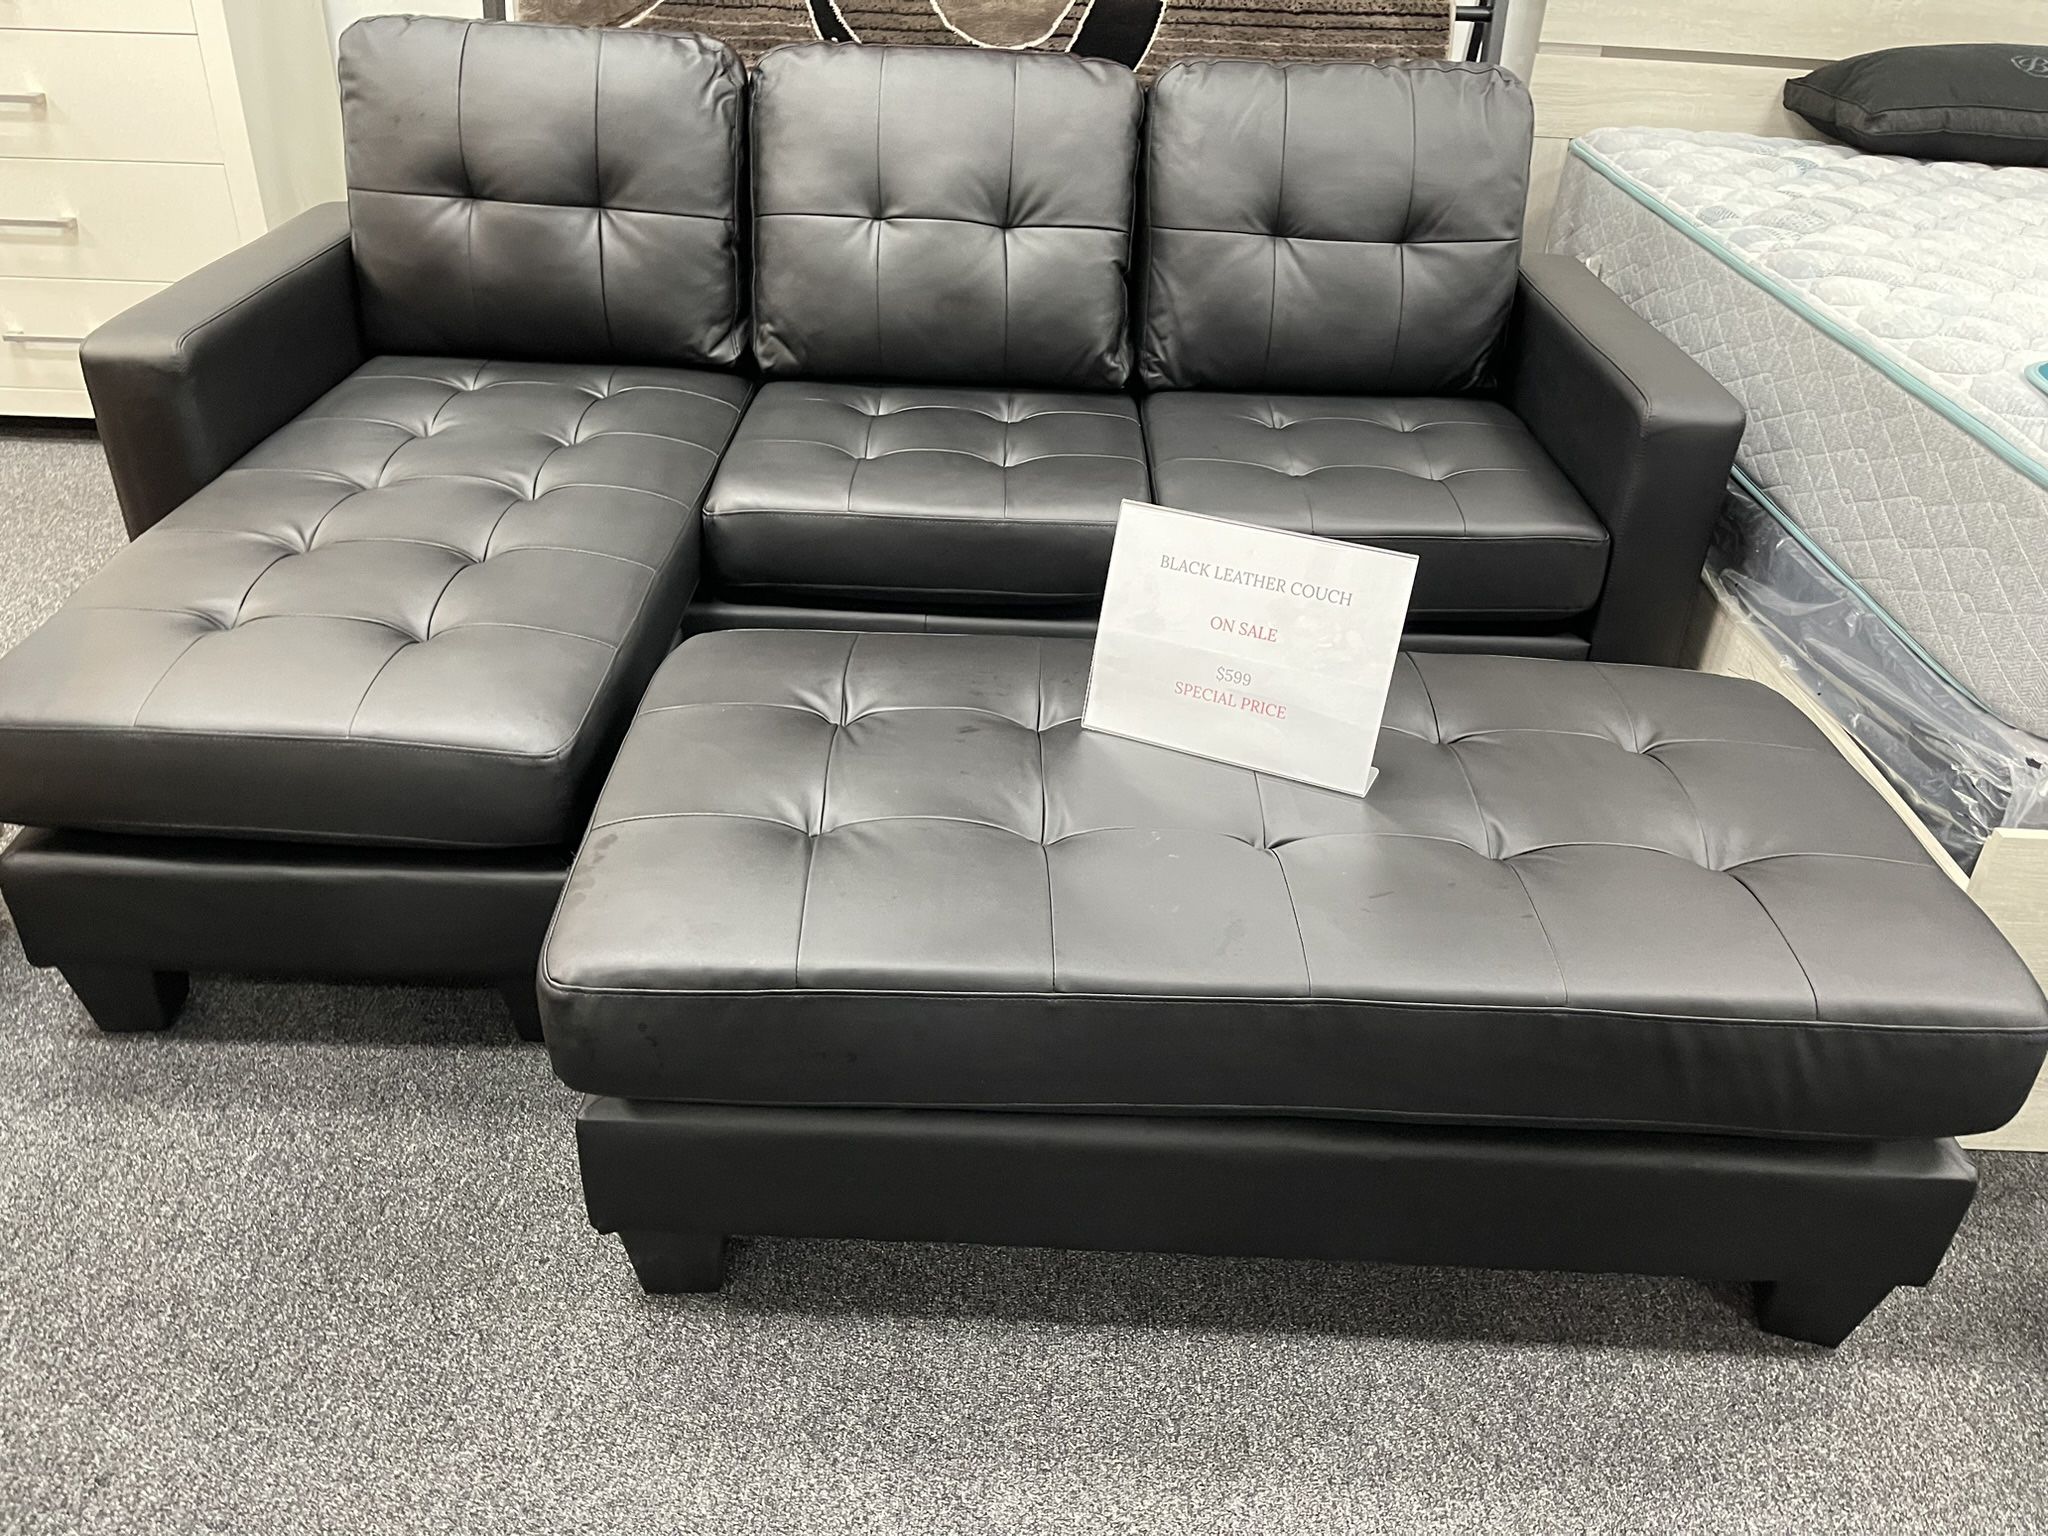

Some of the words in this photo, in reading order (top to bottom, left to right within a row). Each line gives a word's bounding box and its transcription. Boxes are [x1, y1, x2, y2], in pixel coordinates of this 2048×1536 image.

[1160, 554, 1210, 578] BLACK
[1214, 566, 1287, 593] LEATHER
[1290, 581, 1352, 606] COUCH
[1210, 616, 1236, 633] ON
[1238, 622, 1278, 643] SALE
[1216, 666, 1252, 687] $599
[1174, 681, 1237, 708] SPECIAL
[1241, 697, 1287, 719] PRICE
